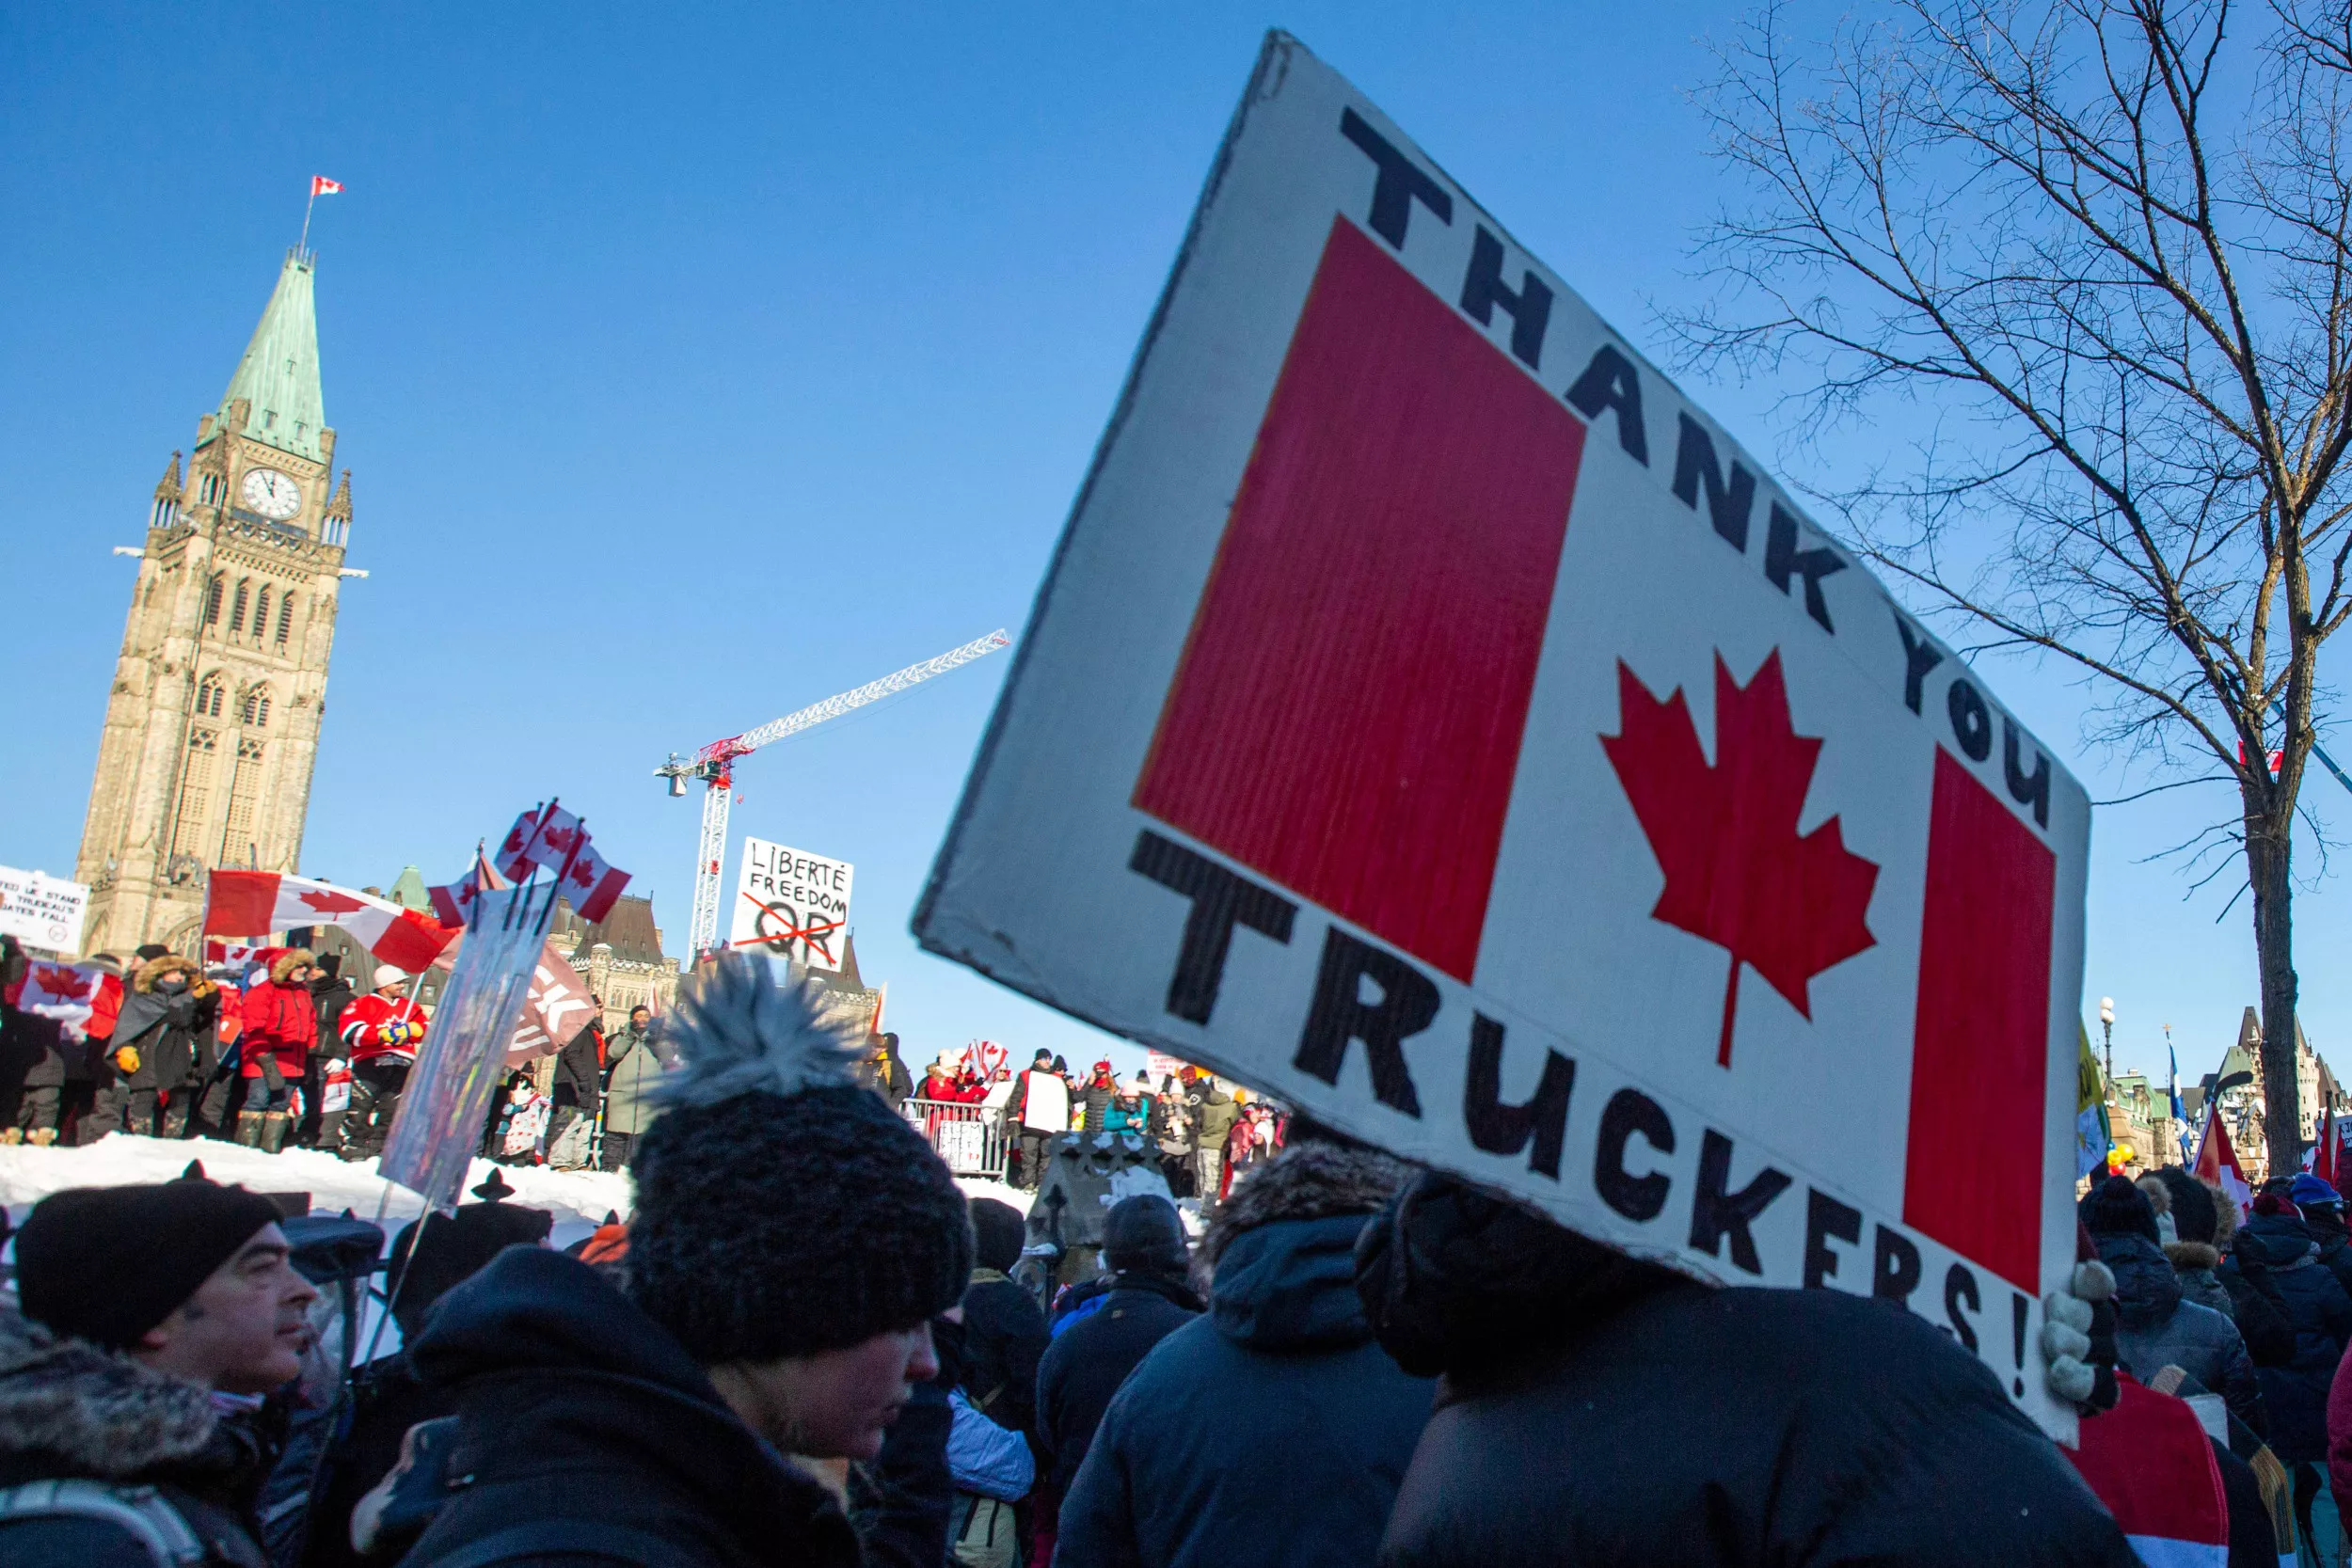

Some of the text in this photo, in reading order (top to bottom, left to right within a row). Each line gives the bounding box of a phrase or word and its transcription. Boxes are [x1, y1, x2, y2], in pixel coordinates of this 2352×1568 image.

[1340, 105, 2052, 831] THANK YOU
[752, 843, 846, 893] LIBERTÉ
[17, 895, 75, 914] TRUDEAU'S
[40, 911, 68, 924] FALL
[45, 892, 81, 905] STAND
[750, 872, 847, 924] FREEDOM
[755, 901, 834, 967] QR
[1128, 827, 2030, 1399] TRUCKERS!
